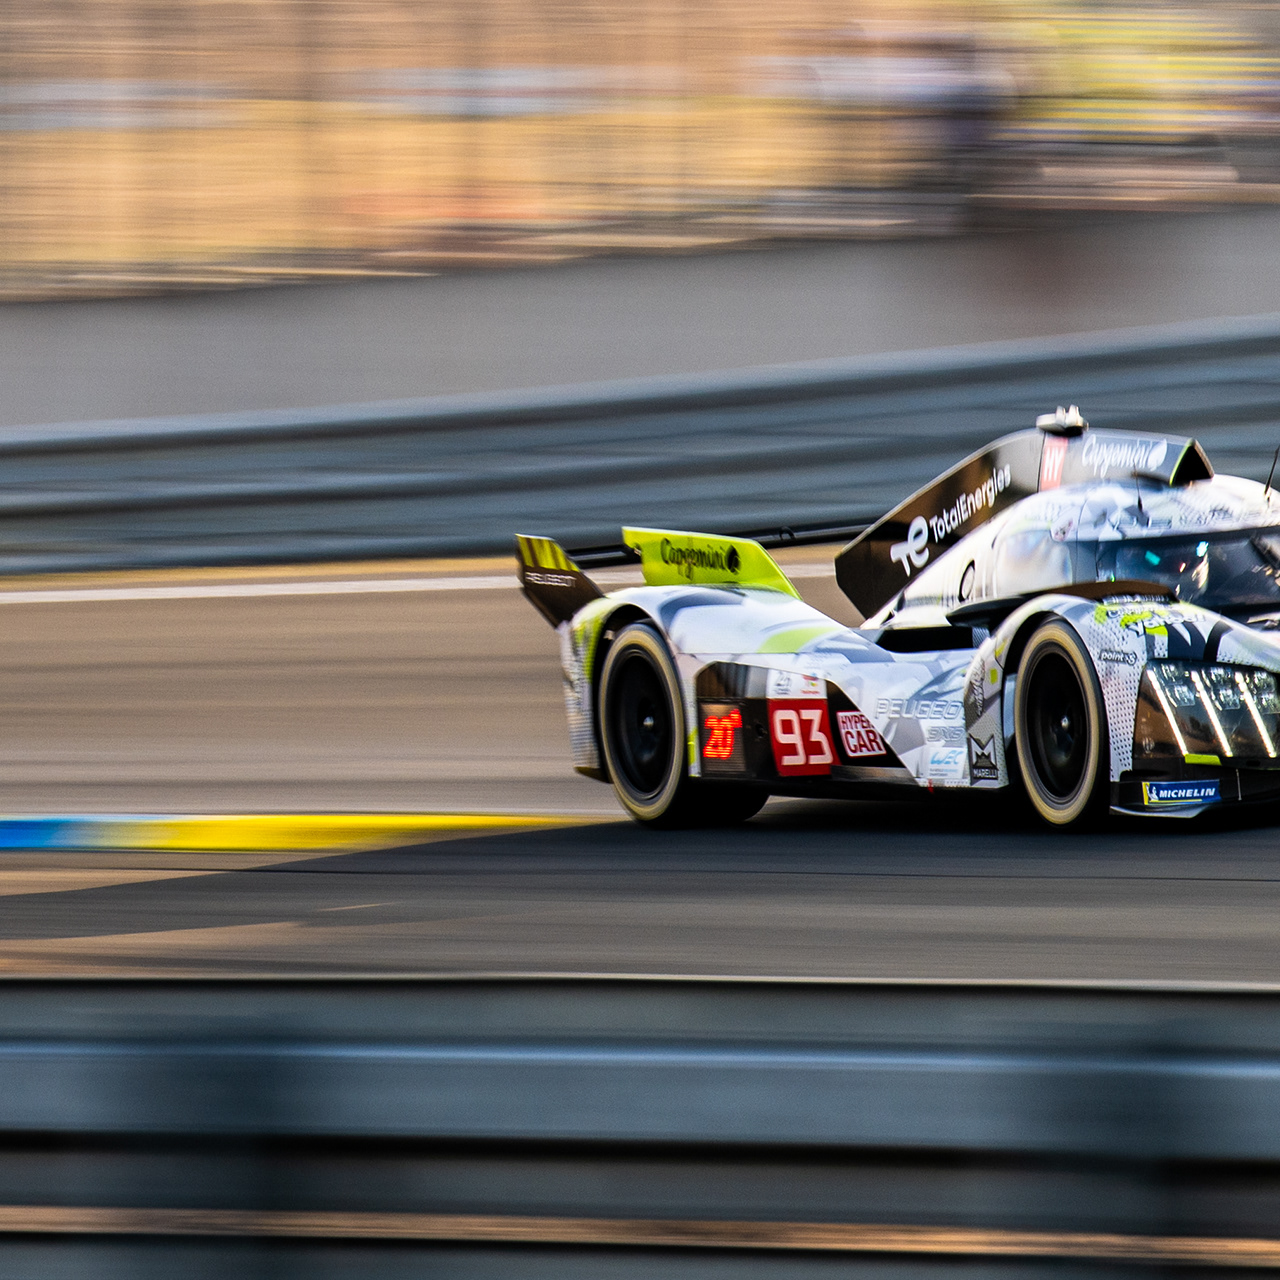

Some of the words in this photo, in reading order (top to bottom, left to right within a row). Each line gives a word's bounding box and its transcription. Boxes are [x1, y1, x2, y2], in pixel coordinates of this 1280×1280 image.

[1043, 446, 1065, 482] HY
[1082, 433, 1153, 479] Capgemini
[929, 463, 1012, 543] TotalEnergies
[660, 537, 725, 581] Capgemini
[875, 697, 964, 720] PEUGEO
[773, 709, 834, 767] 93
[845, 729, 883, 754] CAR
[930, 749, 964, 765] WEC
[972, 767, 998, 778] MARELLI
[1159, 787, 1216, 799] MICHELIN
